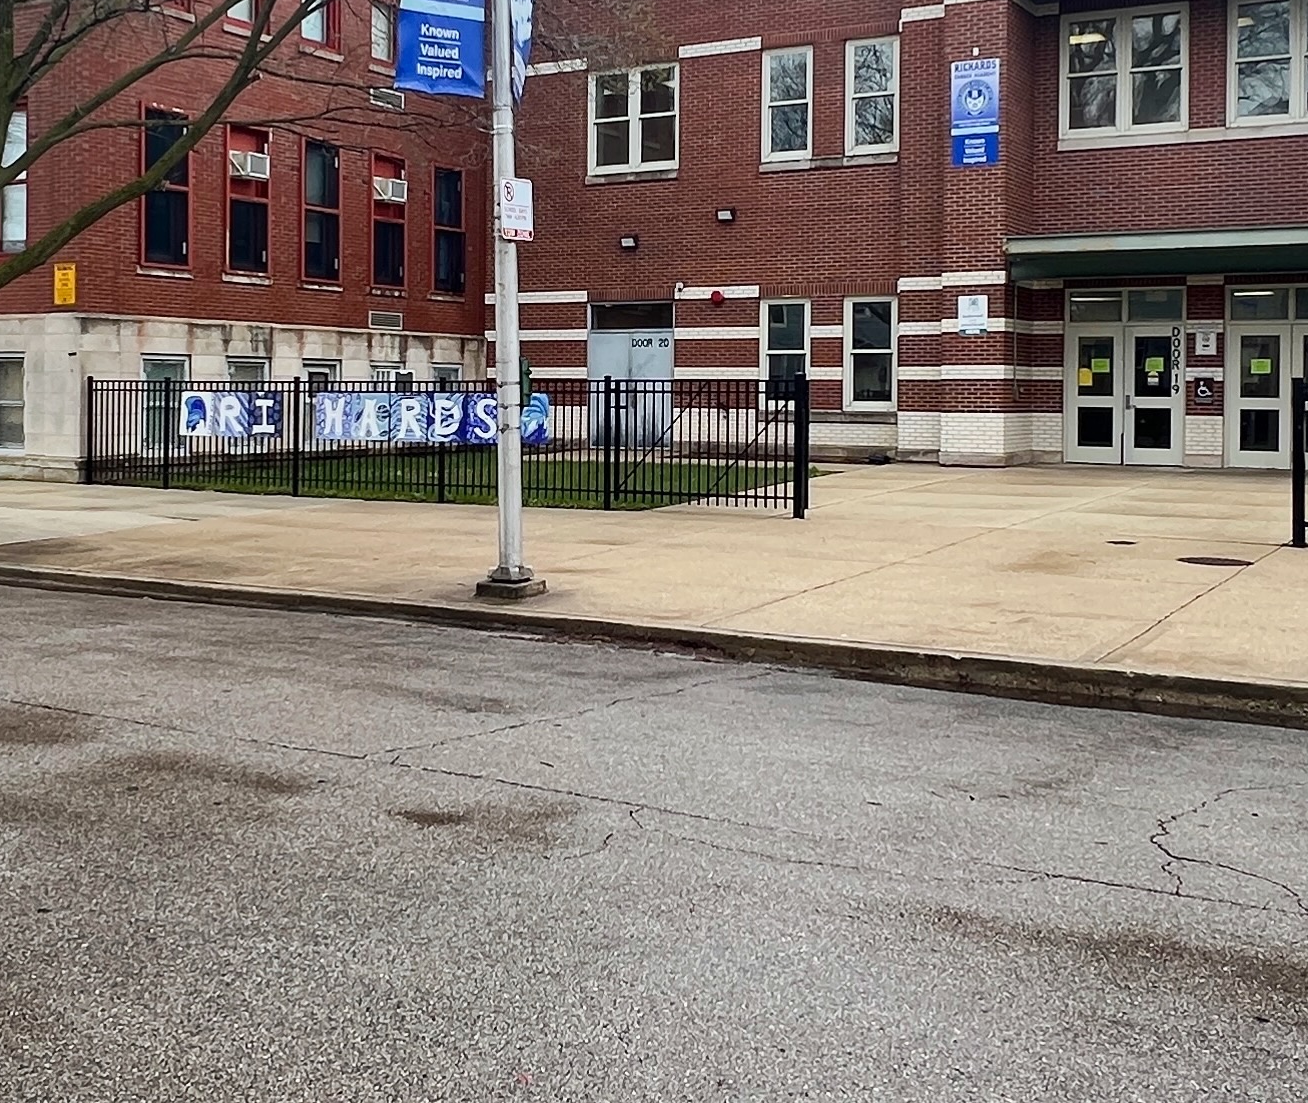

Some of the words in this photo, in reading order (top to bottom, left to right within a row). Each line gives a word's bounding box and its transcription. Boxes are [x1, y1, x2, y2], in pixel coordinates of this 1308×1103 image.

[421, 22, 460, 40] Known
[420, 43, 459, 59] Valued
[417, 62, 462, 79] Inspired
[954, 60, 997, 72] RICHARDS
[631, 338, 654, 348] DOOR
[658, 337, 670, 348] 20
[1172, 327, 1181, 371] DOOR
[1172, 373, 1180, 394] 19
